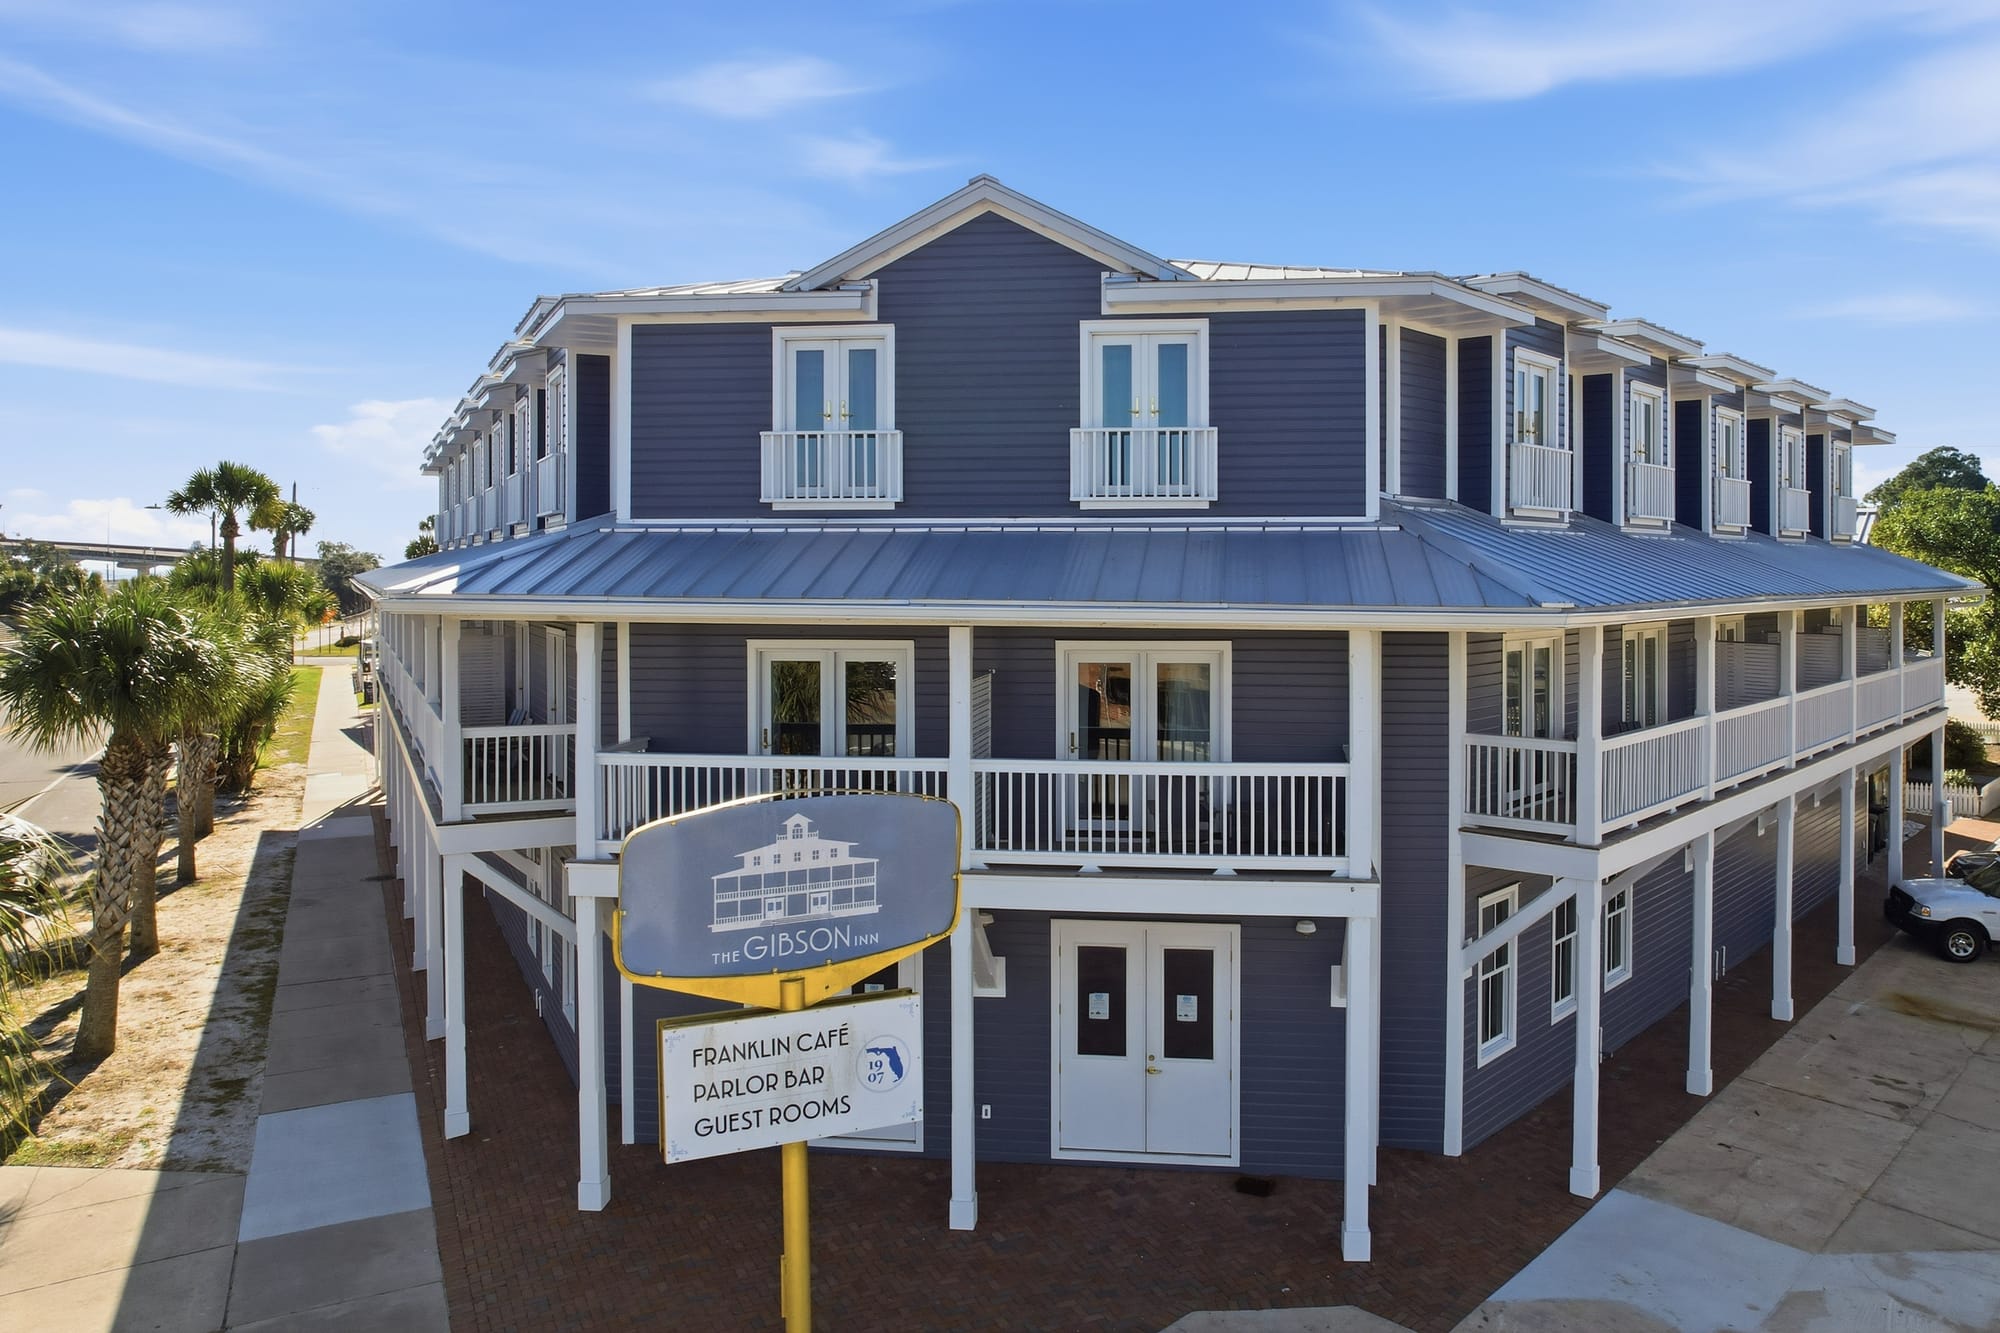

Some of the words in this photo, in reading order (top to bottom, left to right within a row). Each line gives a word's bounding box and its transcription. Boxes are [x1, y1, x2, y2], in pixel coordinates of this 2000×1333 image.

[712, 950, 740, 965] THE
[743, 925, 850, 960] GIBSON
[854, 932, 879, 946] INN
[692, 1036, 790, 1068] FRANKLIN
[797, 1022, 849, 1052] CAFÉ
[693, 1073, 778, 1103] PARLOR
[785, 1066, 825, 1089] BAR
[867, 1072, 884, 1085] 07
[868, 1059, 883, 1072] 19
[694, 1109, 763, 1137] GUEST
[769, 1095, 851, 1126] ROOMS
